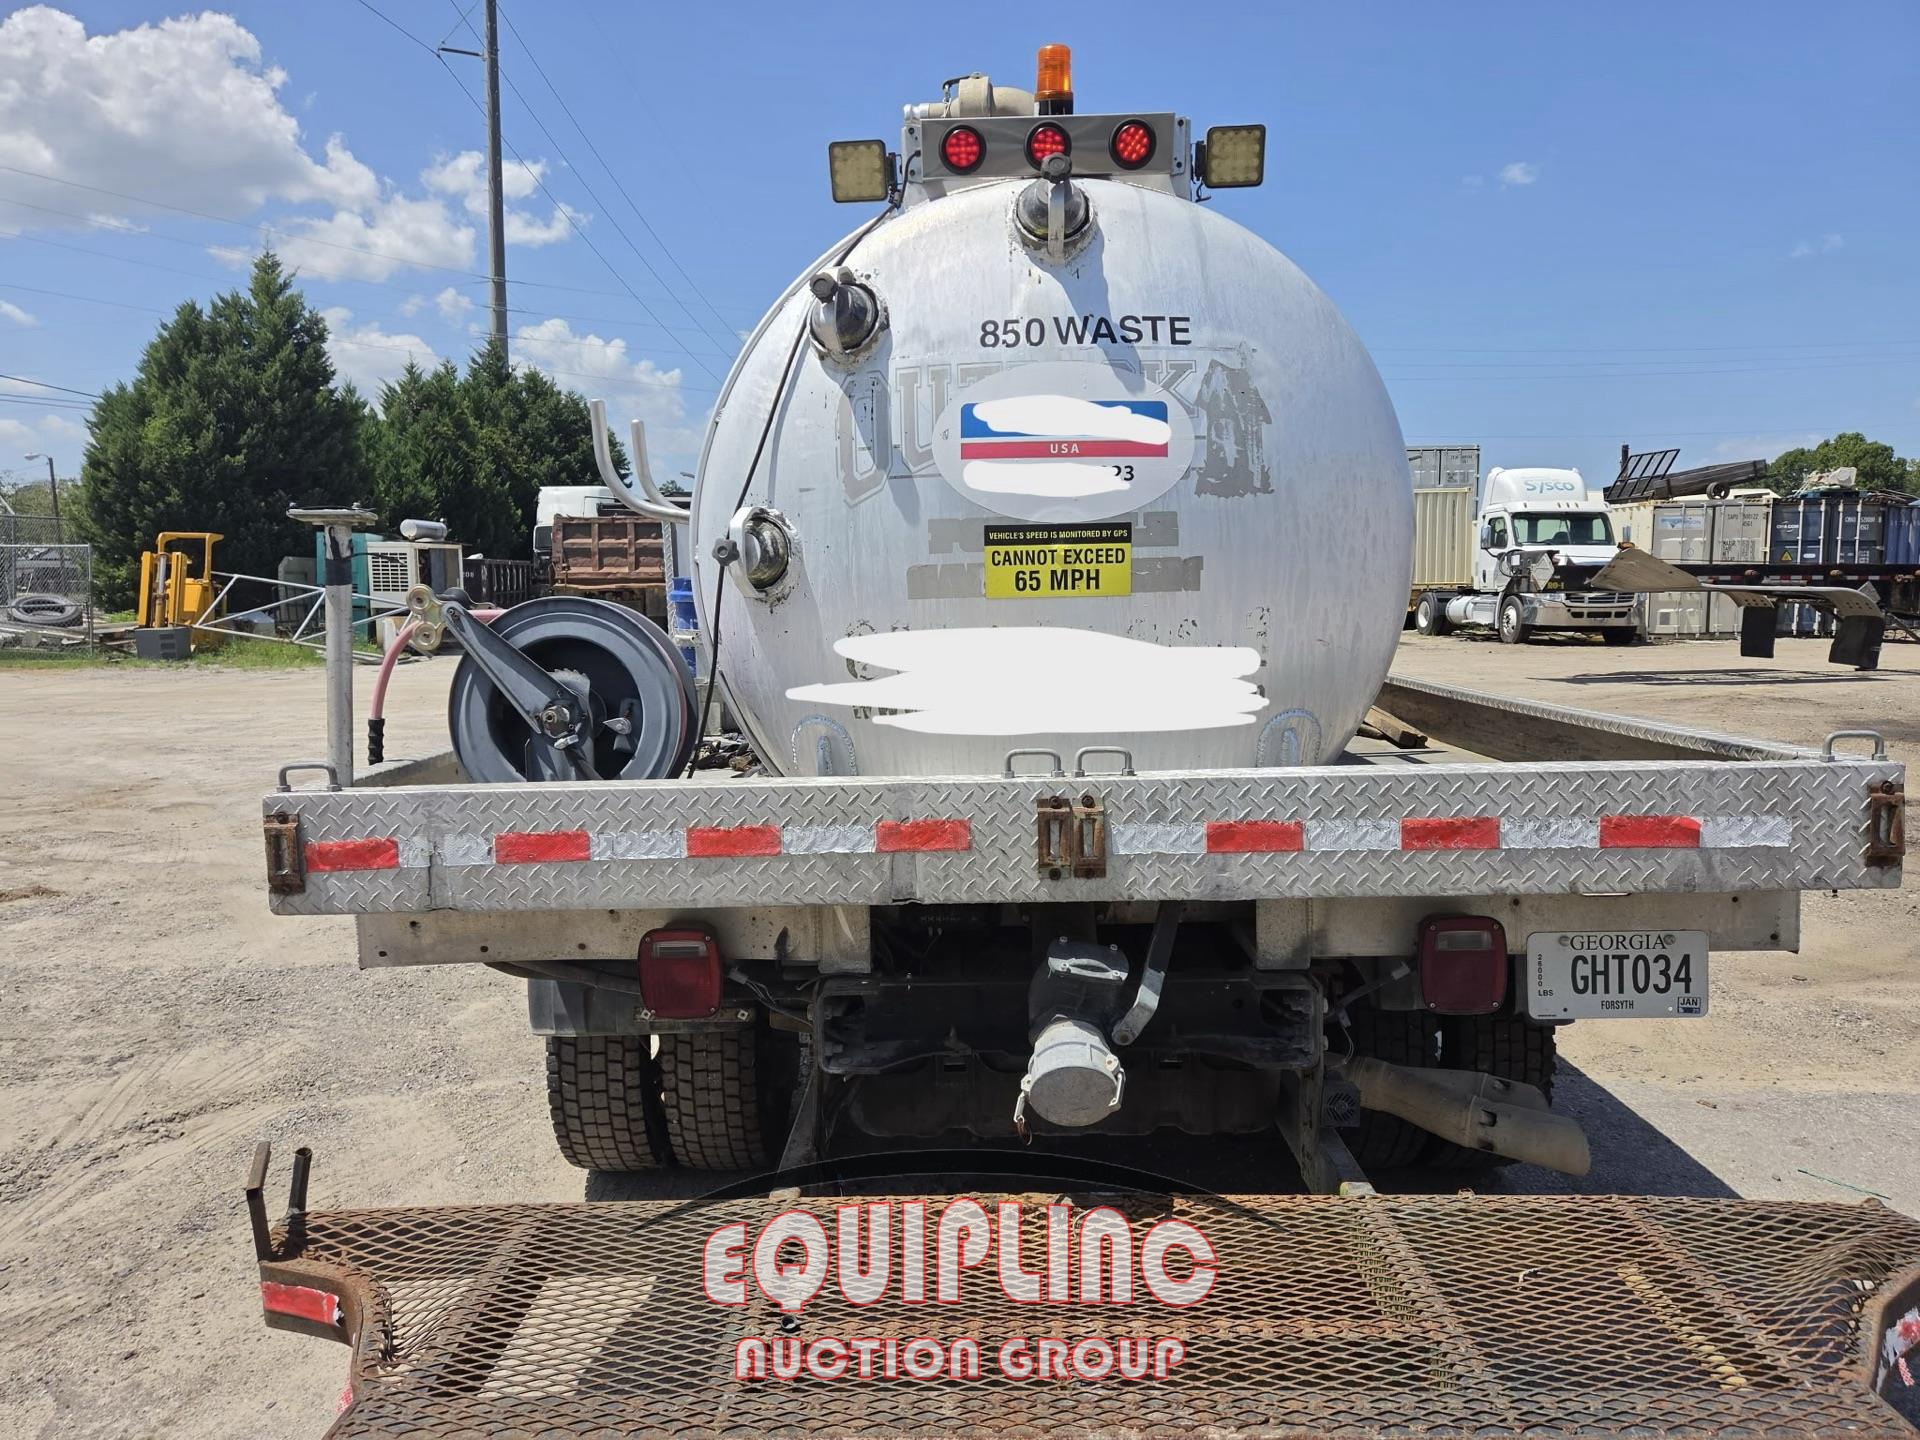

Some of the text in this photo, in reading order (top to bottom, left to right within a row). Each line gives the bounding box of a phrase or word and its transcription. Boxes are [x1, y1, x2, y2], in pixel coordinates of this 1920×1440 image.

[980, 315, 1192, 348] 850 WASTE
[1050, 443, 1080, 454] USA
[989, 529, 1128, 540] VEHICLE'S SPEED IS MONITORED BY GPS
[991, 548, 1126, 566] CANNOT EXCEED
[1014, 568, 1100, 592] 65 MPH
[1570, 934, 1667, 950] GEORGIA
[1571, 953, 1692, 995] GHT034
[1538, 989, 1554, 997] LBS
[1600, 1000, 1634, 1010] FORSYTH
[1680, 998, 1698, 1006] JAN
